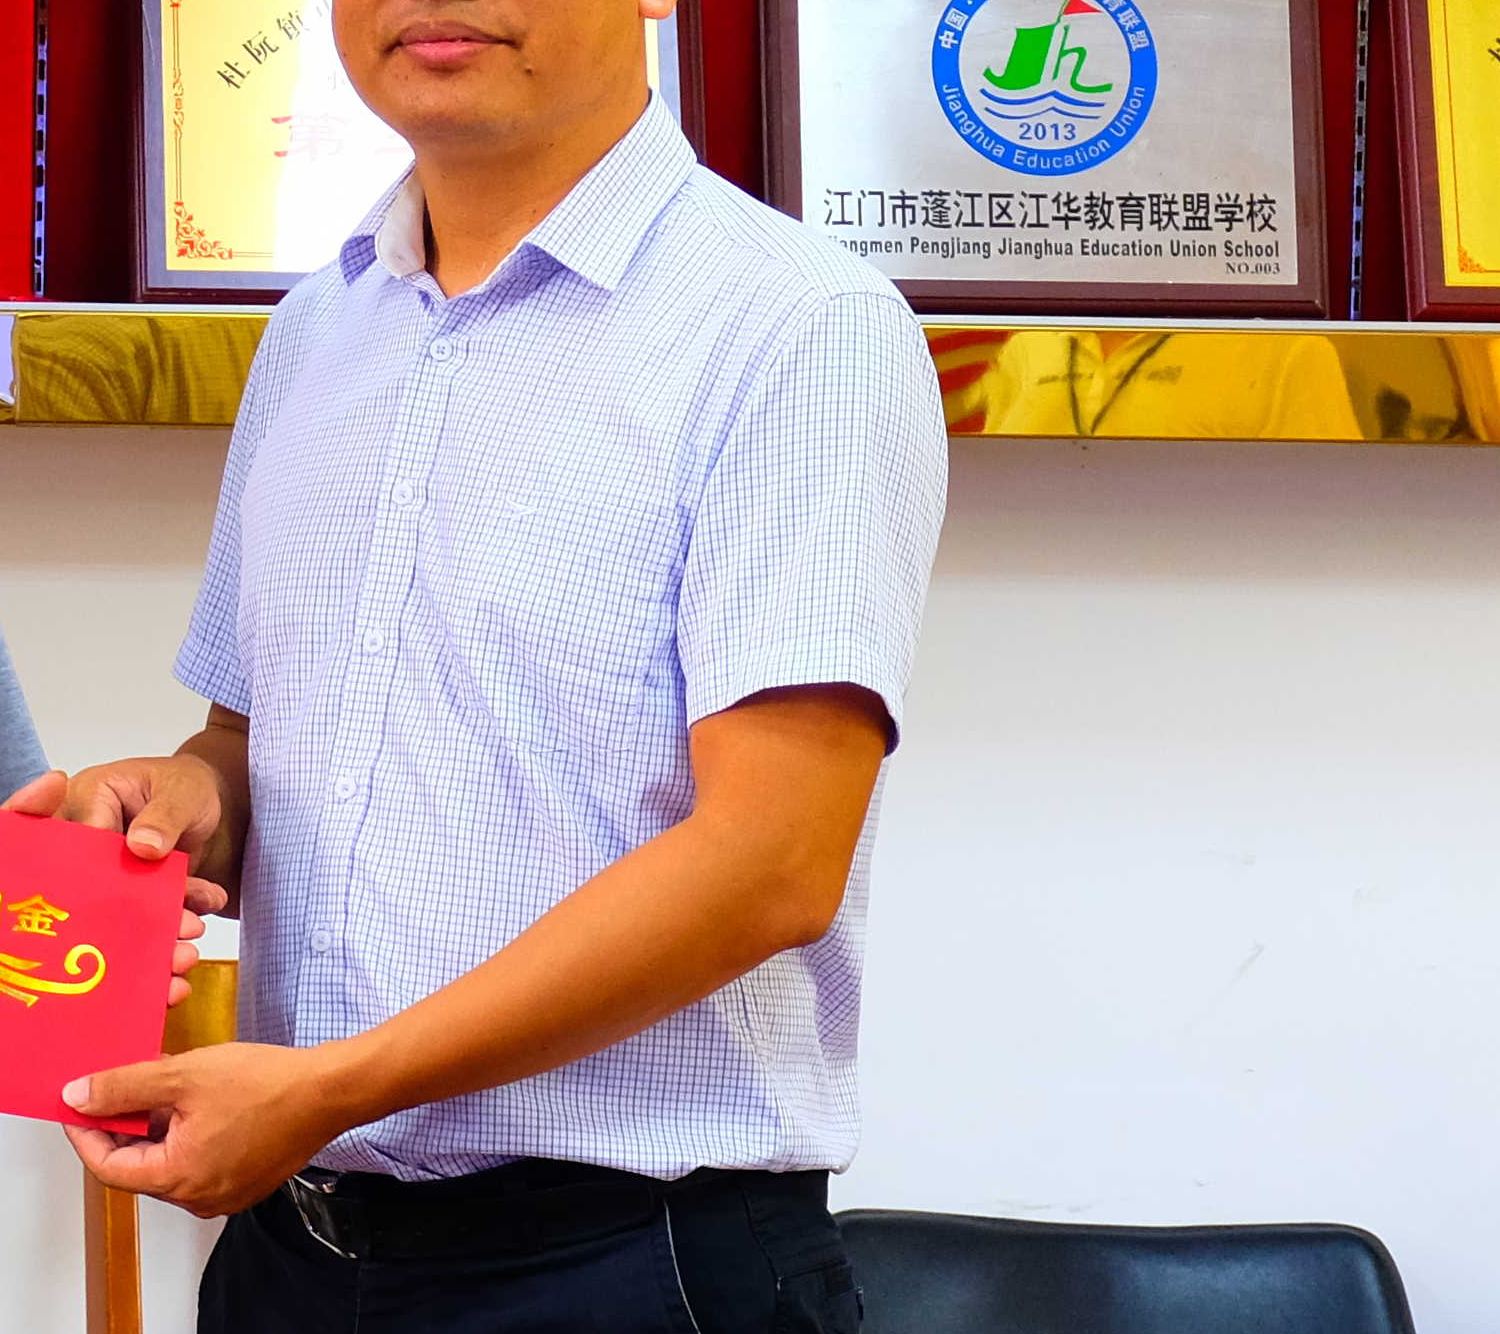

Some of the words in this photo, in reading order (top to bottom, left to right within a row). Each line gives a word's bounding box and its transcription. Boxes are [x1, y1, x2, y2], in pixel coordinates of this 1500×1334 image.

[942, 84, 1006, 158] Jianghua
[1012, 136, 1111, 170] Education
[1109, 85, 1145, 139] Union
[1019, 123, 1076, 141] 2013
[823, 189, 1278, 233] 江门市蓬江区江华教育联盟学校
[828, 236, 903, 257] angmen
[910, 237, 991, 259] Pengjiang
[998, 238, 1073, 259] Jianghua
[1081, 238, 1163, 258] Education
[1169, 239, 1217, 258] Union
[1224, 240, 1279, 258] School
[1226, 262, 1280, 275] NO.003
